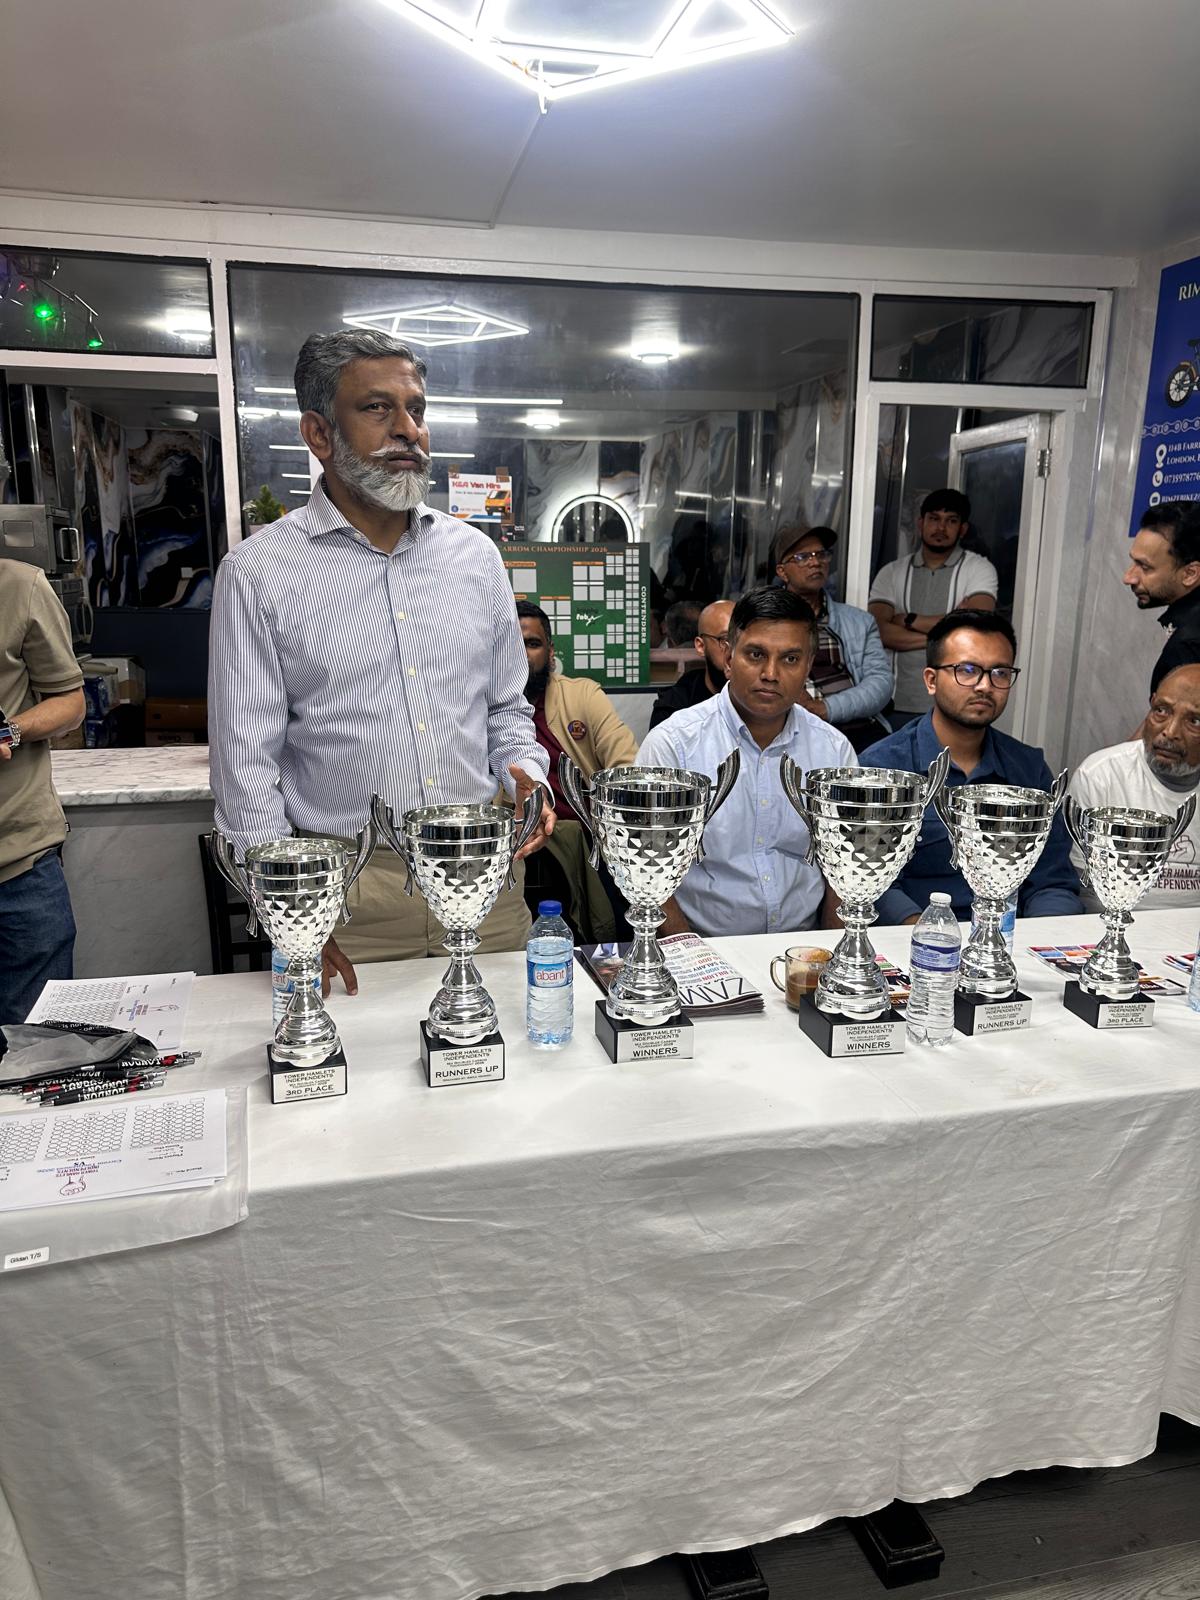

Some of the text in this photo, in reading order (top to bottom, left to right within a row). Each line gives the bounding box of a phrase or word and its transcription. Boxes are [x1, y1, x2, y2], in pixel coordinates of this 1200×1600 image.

[536, 970, 565, 981] abant
[978, 1020, 1014, 1030] RUNNERS
[847, 1041, 890, 1050] WINNERS
[633, 1047, 677, 1057] WINNERS
[436, 1067, 482, 1078] RUNNERS
[84, 1087, 126, 1101] LONDON
[305, 1085, 334, 1093] PLACE
